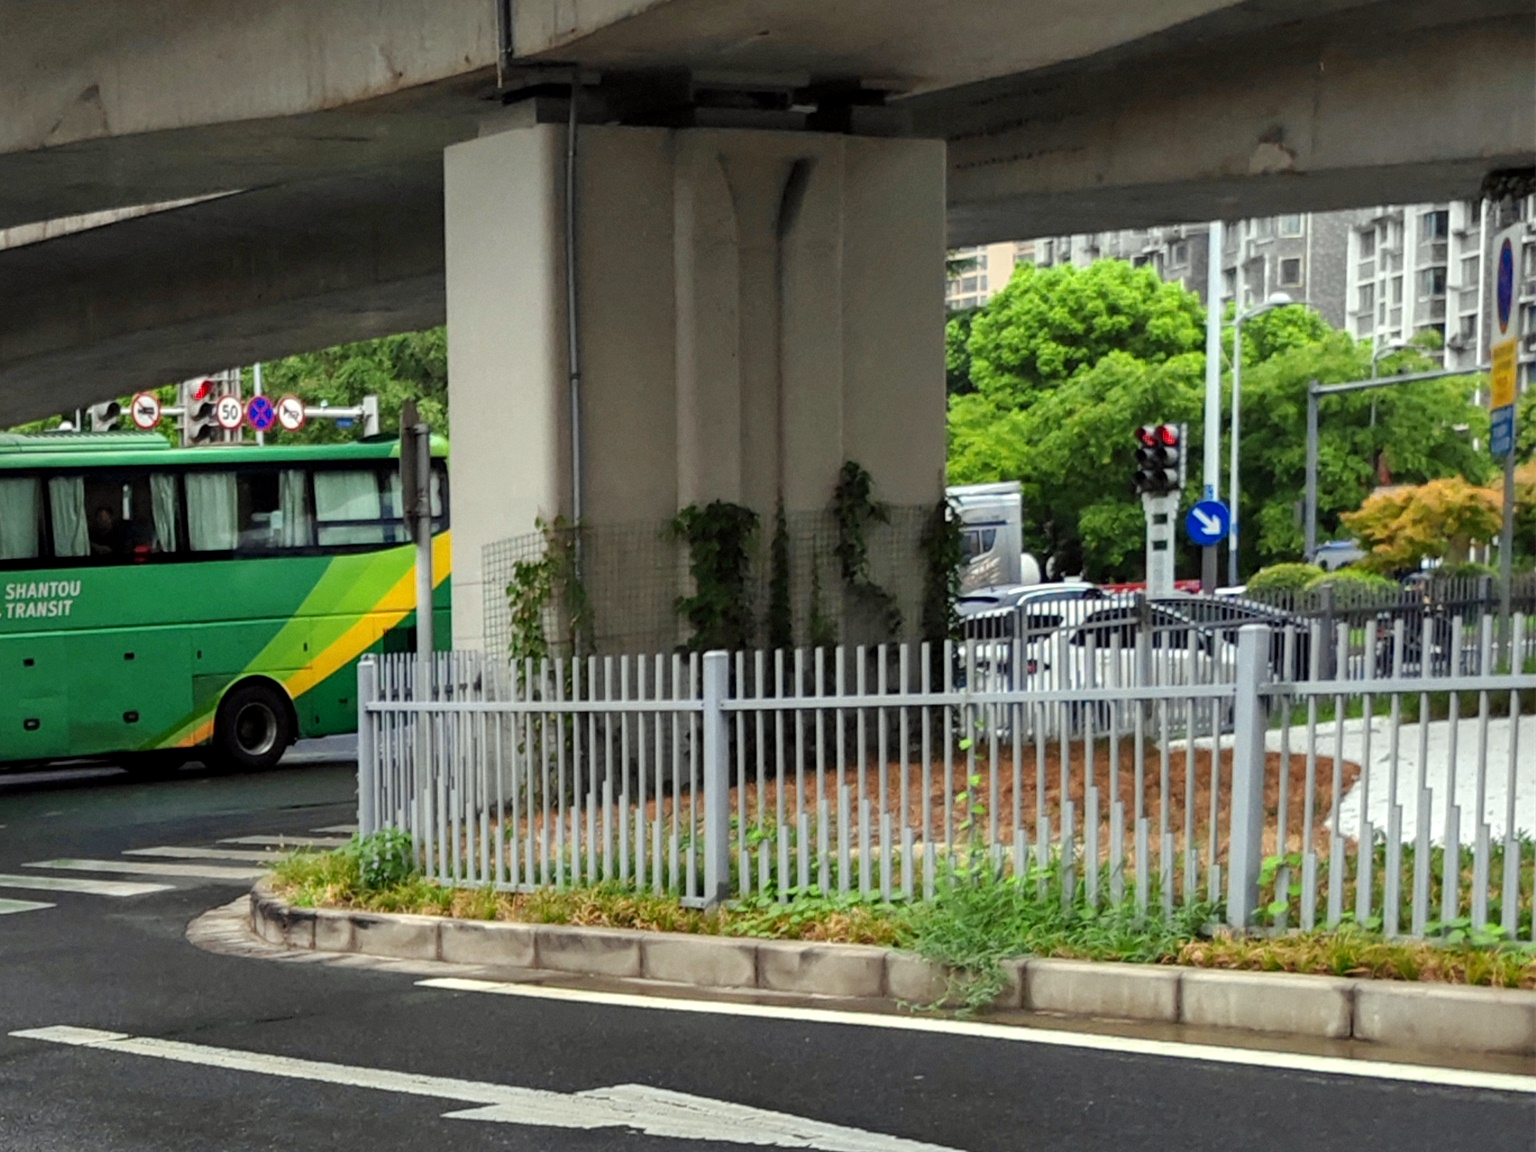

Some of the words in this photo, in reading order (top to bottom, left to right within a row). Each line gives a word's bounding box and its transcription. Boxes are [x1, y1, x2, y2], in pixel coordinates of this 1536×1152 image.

[222, 404, 239, 421] 50
[5, 580, 82, 600] SHANTOU
[5, 600, 74, 619] TRANSIT
